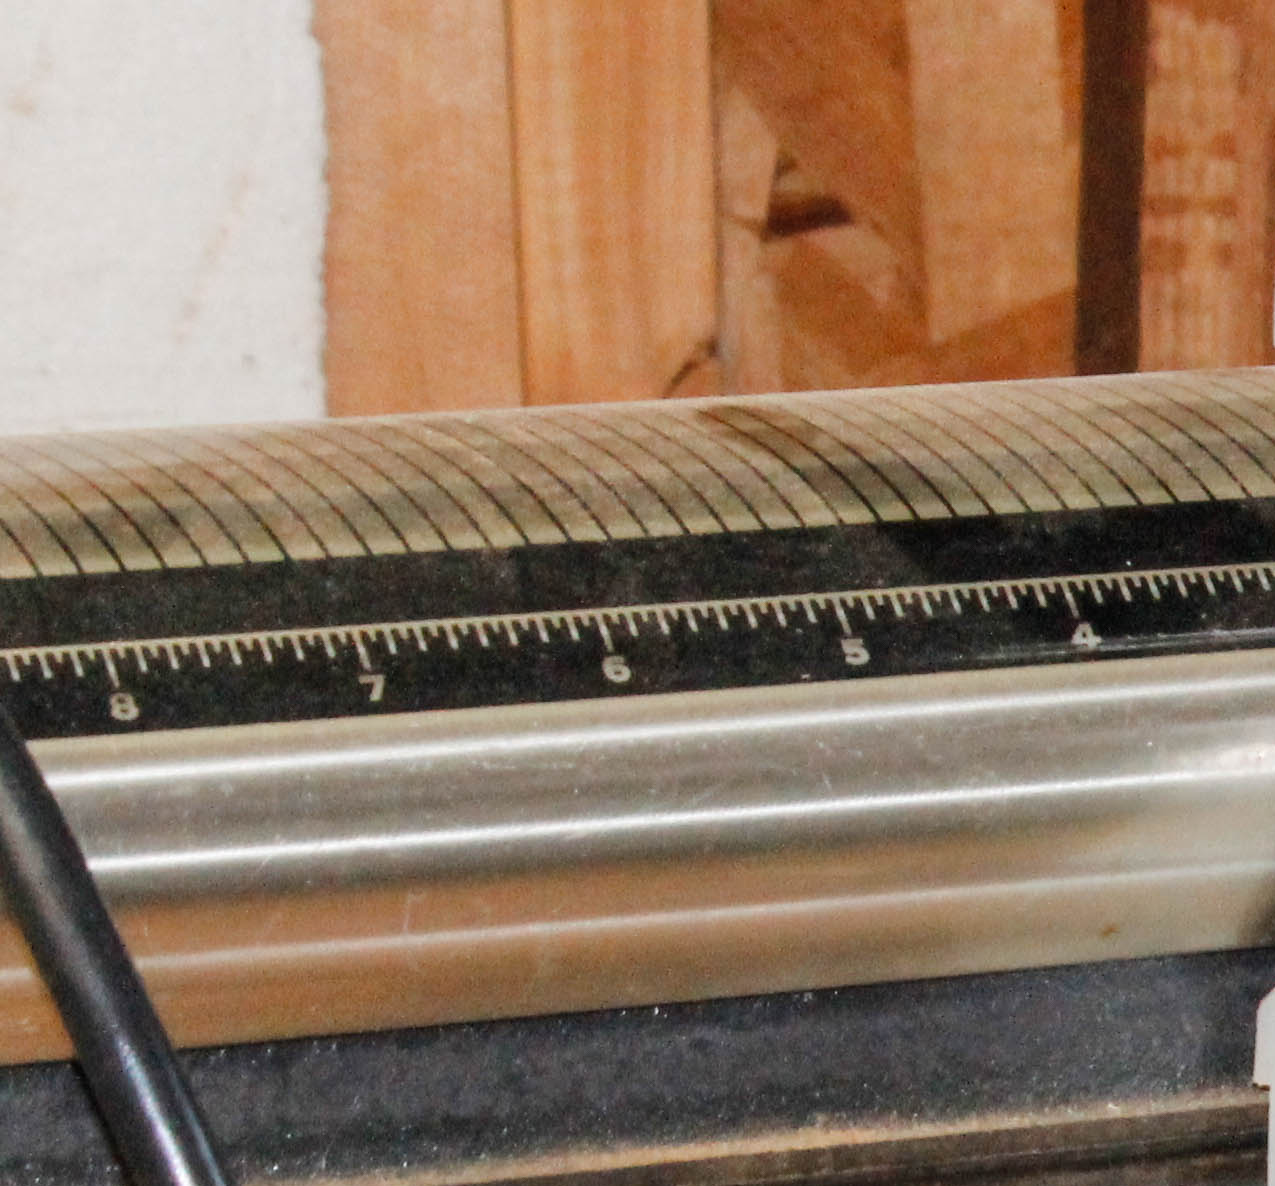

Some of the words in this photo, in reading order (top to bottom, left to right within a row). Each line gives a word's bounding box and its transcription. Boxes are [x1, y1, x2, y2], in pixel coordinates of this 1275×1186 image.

[109, 692, 140, 722] 8
[358, 673, 387, 703] 7
[602, 654, 633, 684] 6
[843, 637, 871, 667] 5
[1070, 621, 1103, 650] 4
